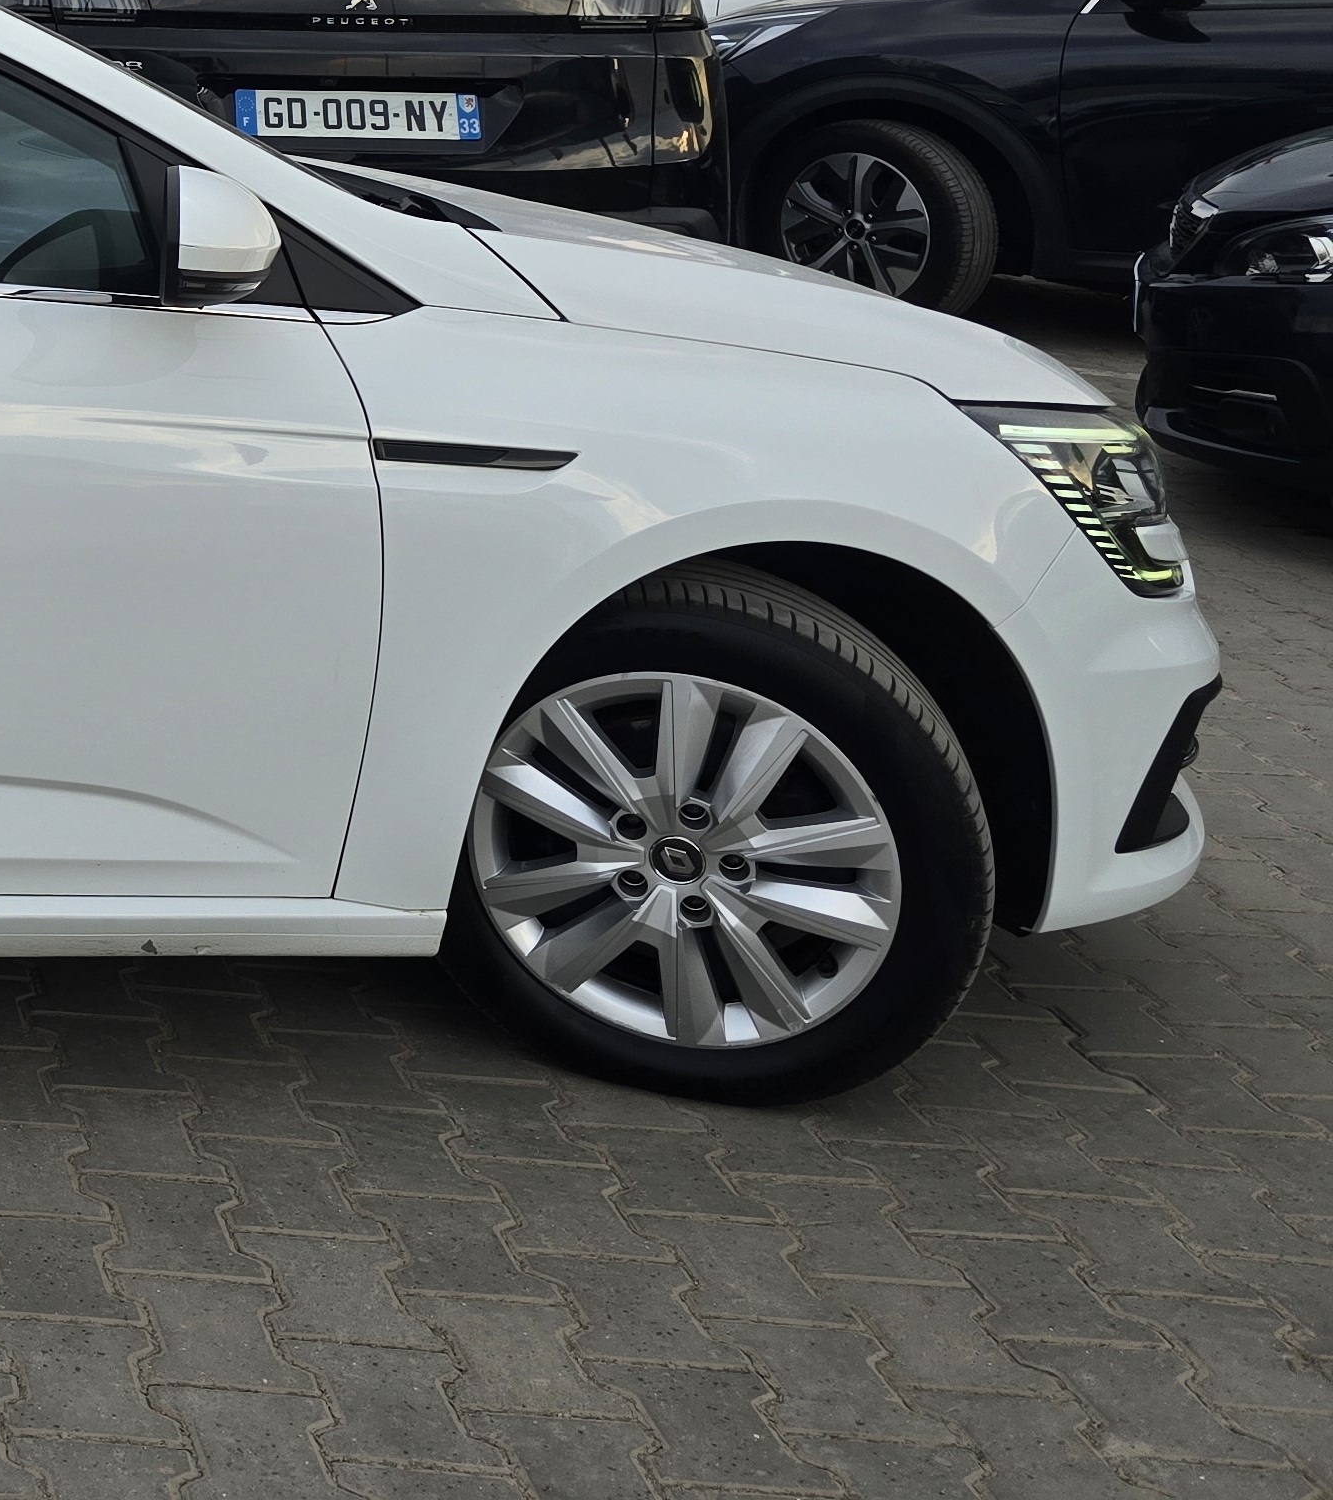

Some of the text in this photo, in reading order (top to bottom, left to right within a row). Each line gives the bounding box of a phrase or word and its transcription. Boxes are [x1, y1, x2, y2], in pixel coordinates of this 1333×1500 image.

[312, 16, 409, 26] PEUGEOT
[263, 97, 448, 132] GD-009-NY
[242, 116, 250, 127] F
[459, 118, 480, 134] 33
